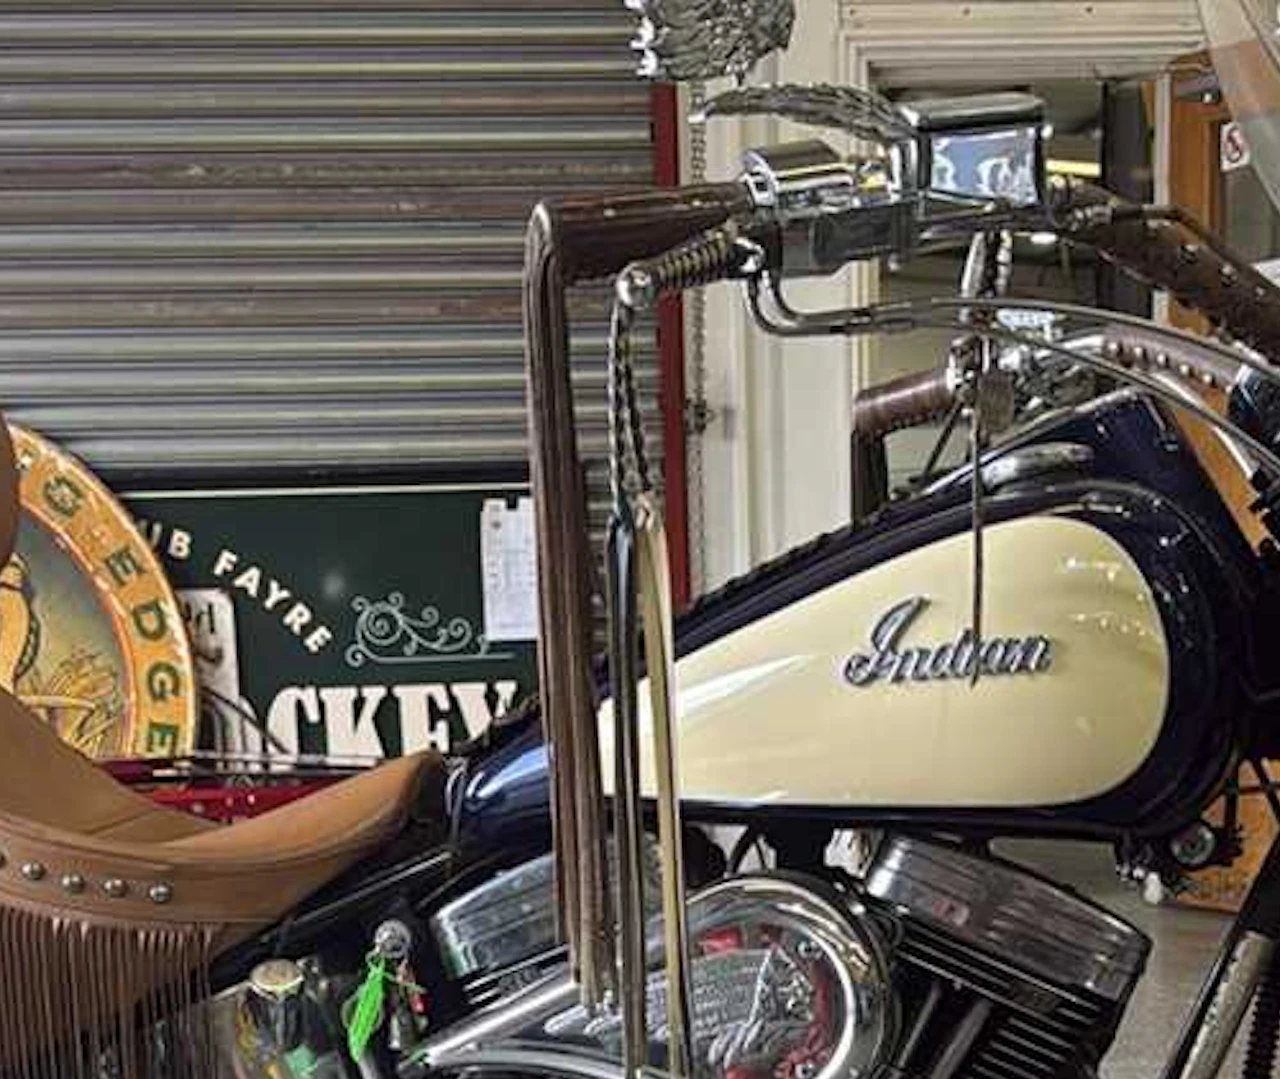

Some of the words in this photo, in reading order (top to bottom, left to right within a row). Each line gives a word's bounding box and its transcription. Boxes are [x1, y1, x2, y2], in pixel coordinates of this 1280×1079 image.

[137, 517, 193, 560] UB
[213, 548, 333, 654] FAYRE
[237, 676, 517, 772] CKEY
